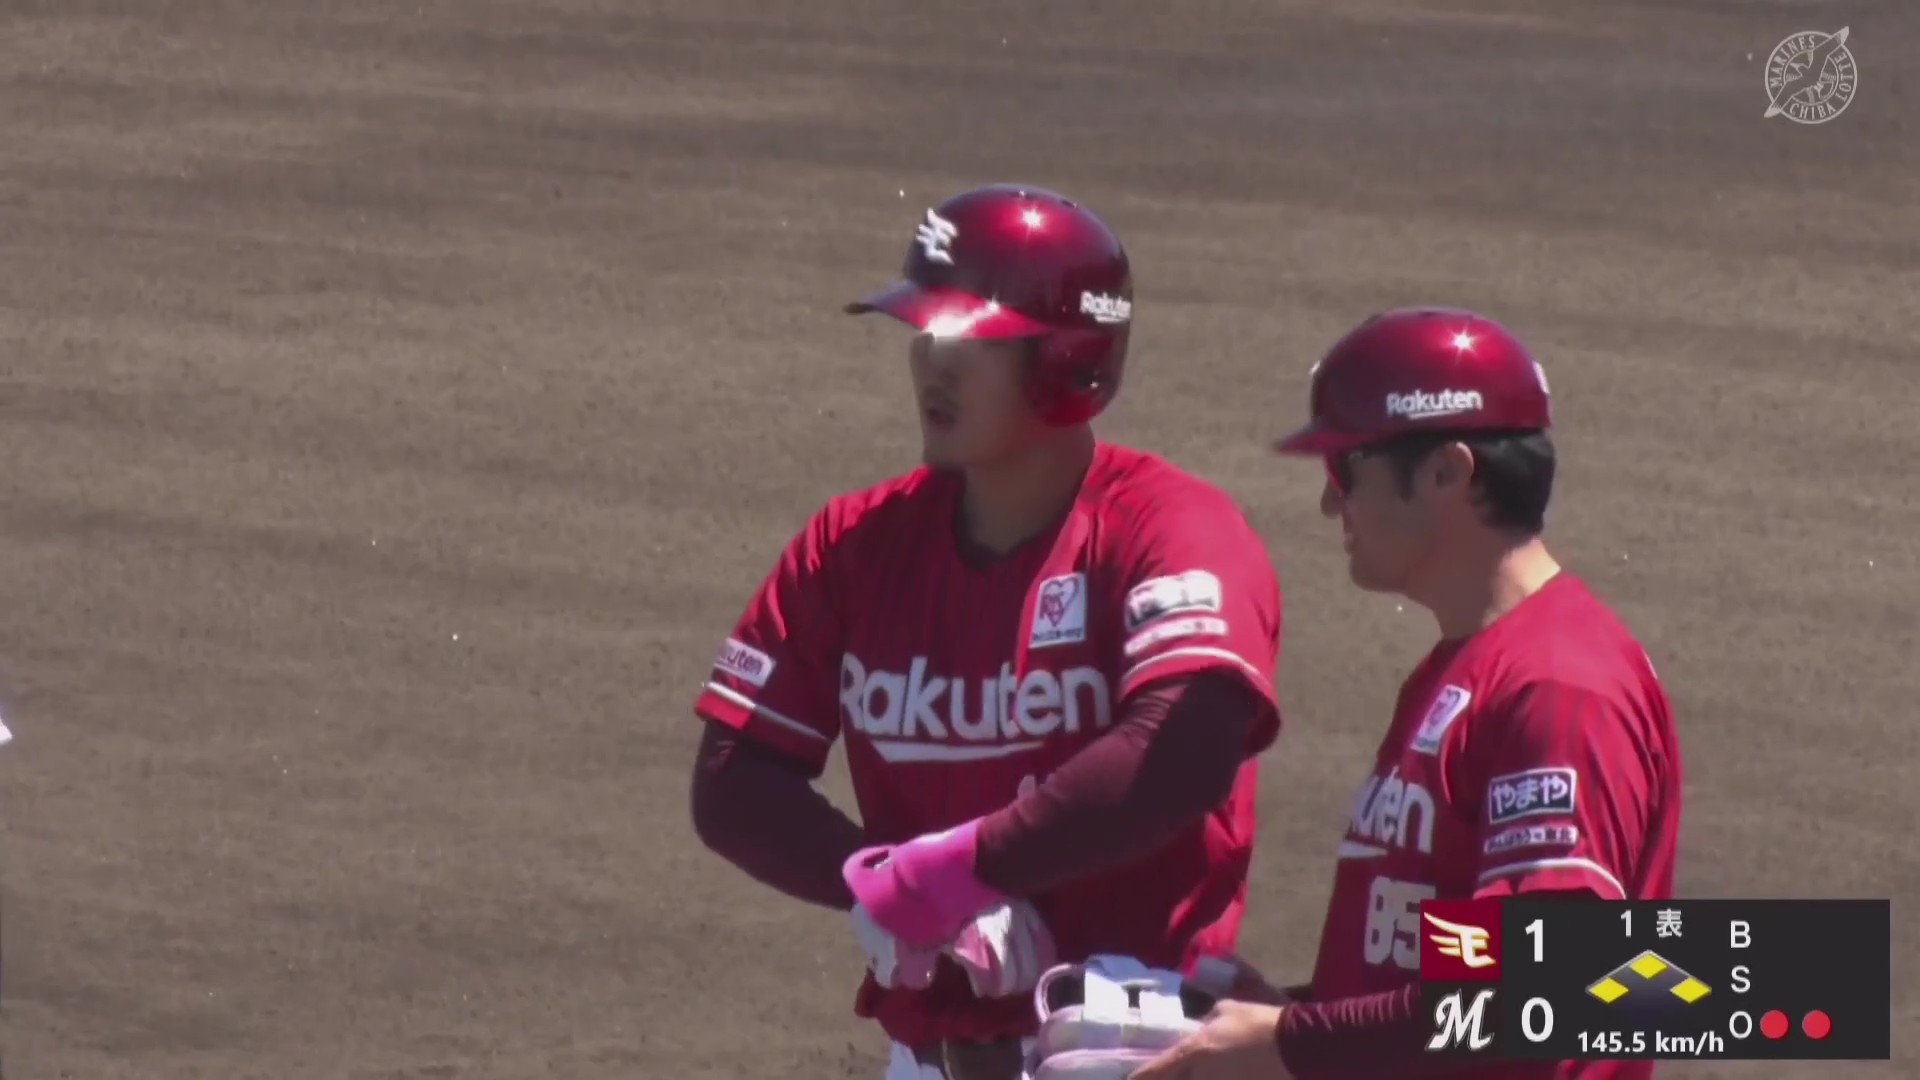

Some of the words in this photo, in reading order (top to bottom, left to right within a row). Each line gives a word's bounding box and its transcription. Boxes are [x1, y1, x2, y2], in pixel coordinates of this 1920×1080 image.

[1386, 388, 1483, 416] Rakuten
[839, 651, 1111, 741] Rakuten
[1492, 773, 1569, 814] やまや
[1364, 875, 1436, 971] 85
